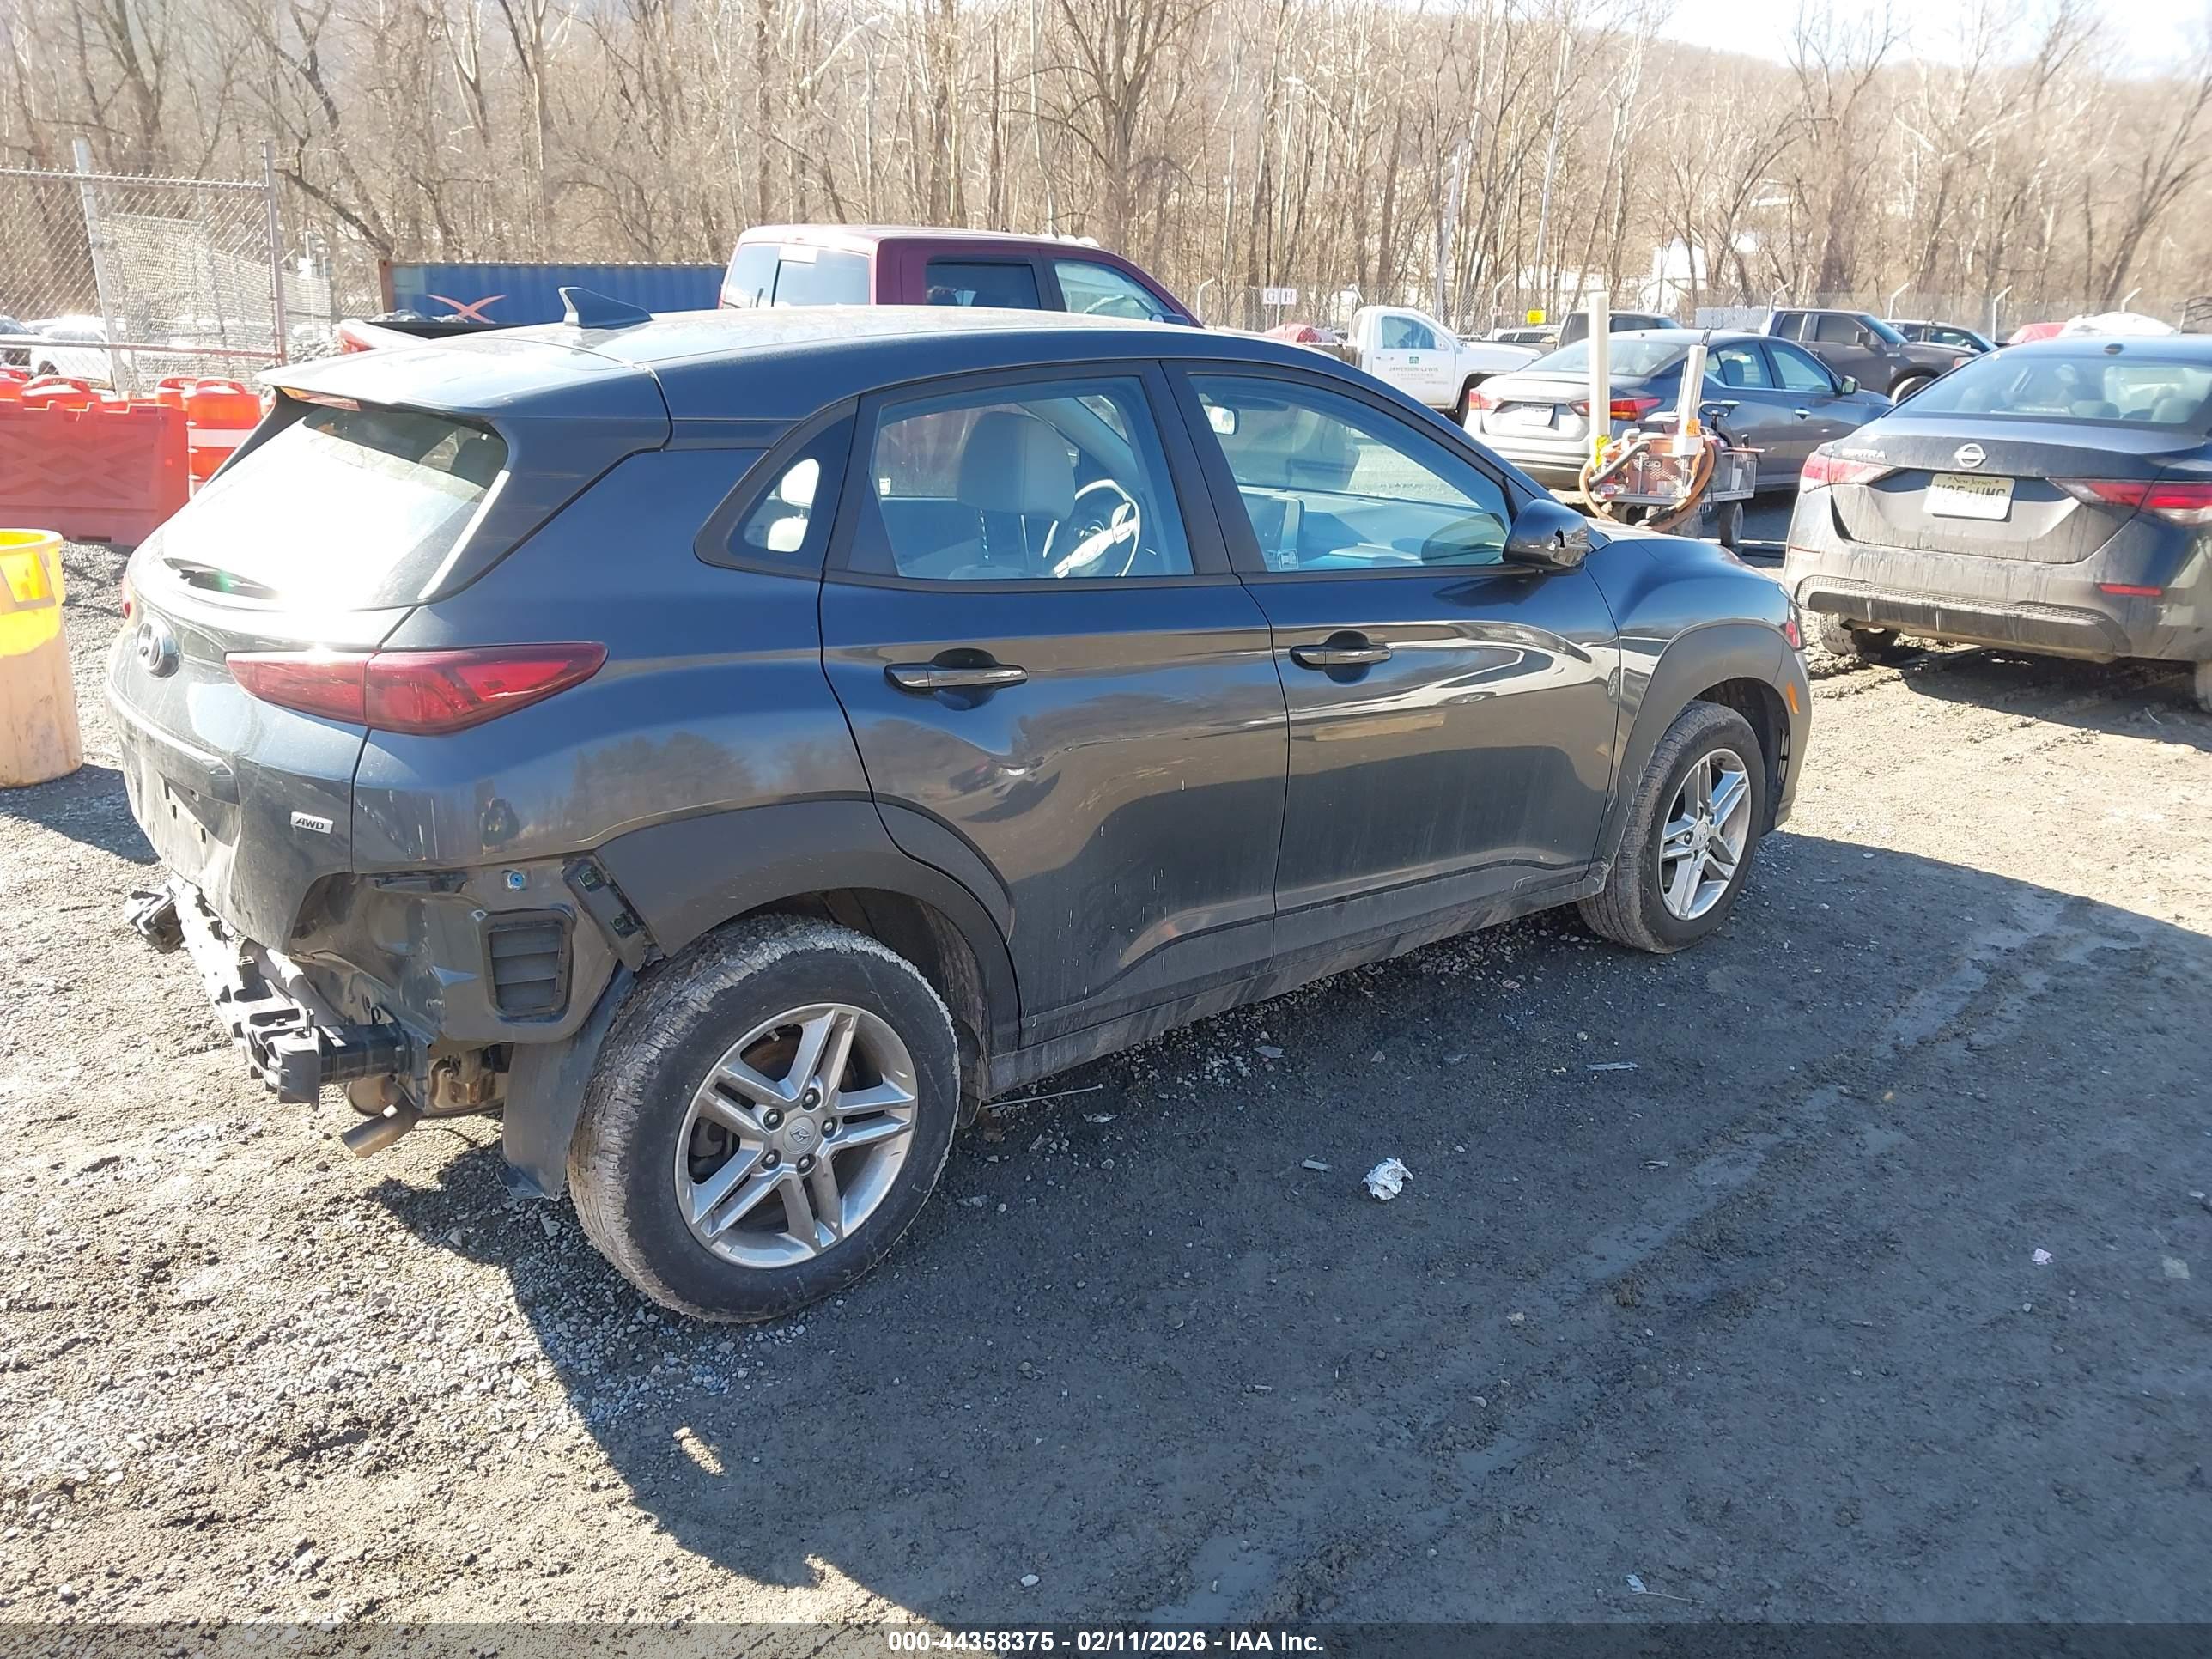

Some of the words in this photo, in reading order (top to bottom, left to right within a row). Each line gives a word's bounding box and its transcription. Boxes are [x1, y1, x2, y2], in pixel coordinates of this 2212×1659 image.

[1266, 291, 1275, 301] G
[1285, 291, 1293, 302] H
[1953, 476, 1969, 485] New
[1971, 477, 1992, 487] Jersey
[295, 817, 325, 830] AWD
